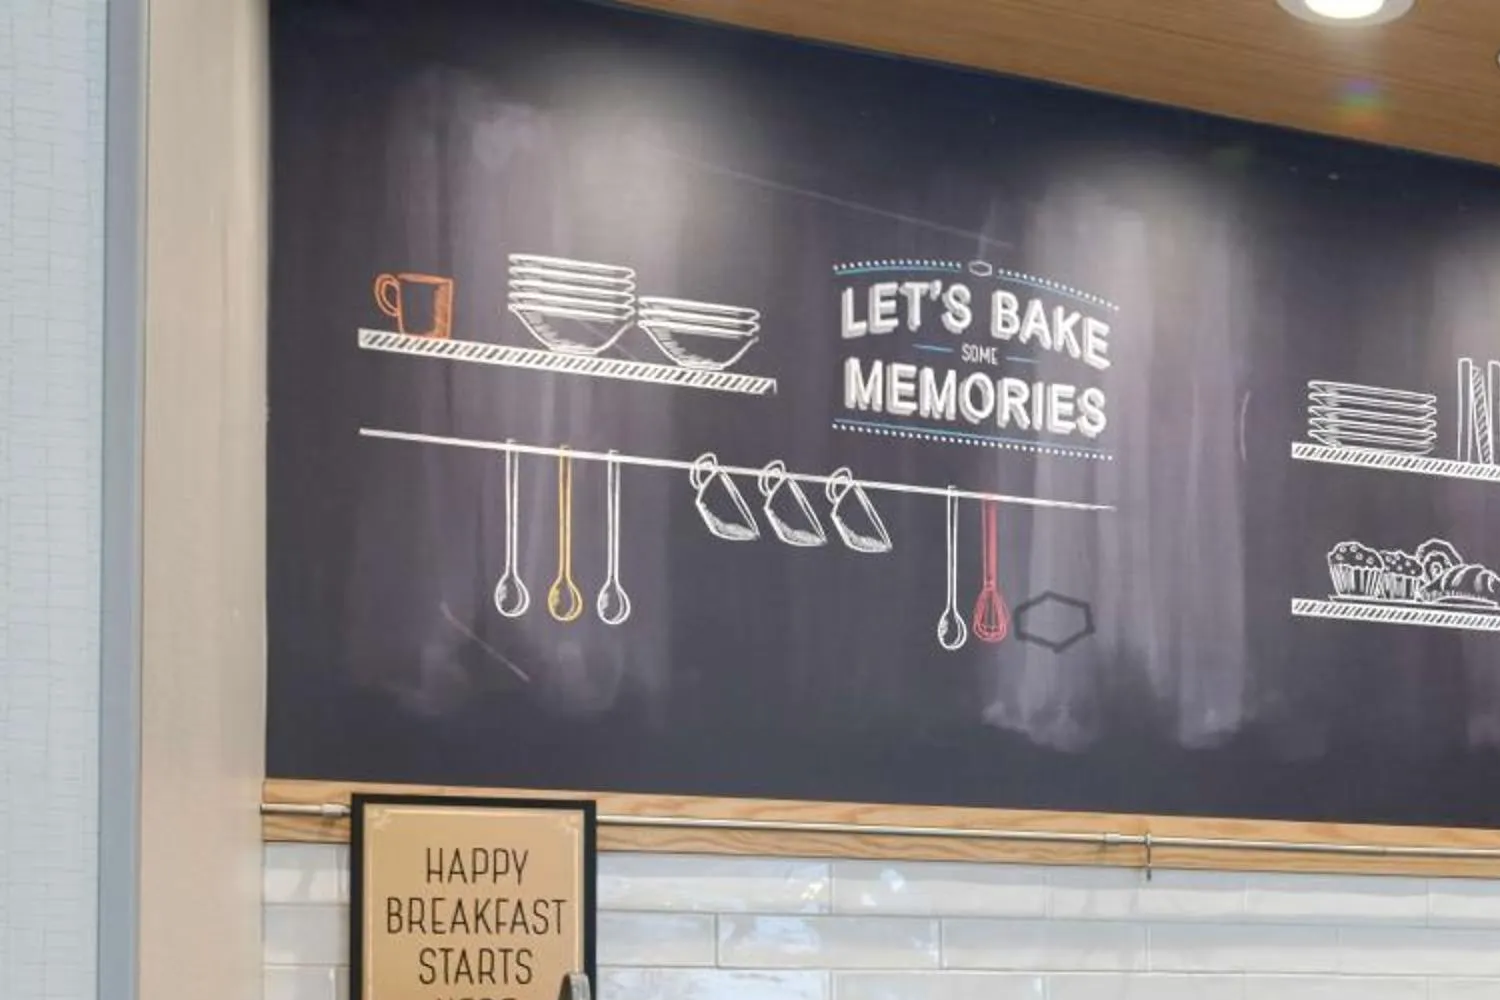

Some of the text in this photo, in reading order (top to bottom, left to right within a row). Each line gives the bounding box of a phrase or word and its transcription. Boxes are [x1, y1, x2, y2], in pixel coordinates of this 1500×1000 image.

[841, 280, 1111, 371] LET'S BAKE
[961, 343, 998, 365] SOME
[844, 356, 1107, 438] MEMORIES
[426, 847, 529, 884] HAPPY
[386, 897, 567, 934] BREAKFAST
[419, 947, 533, 985] STARTS
